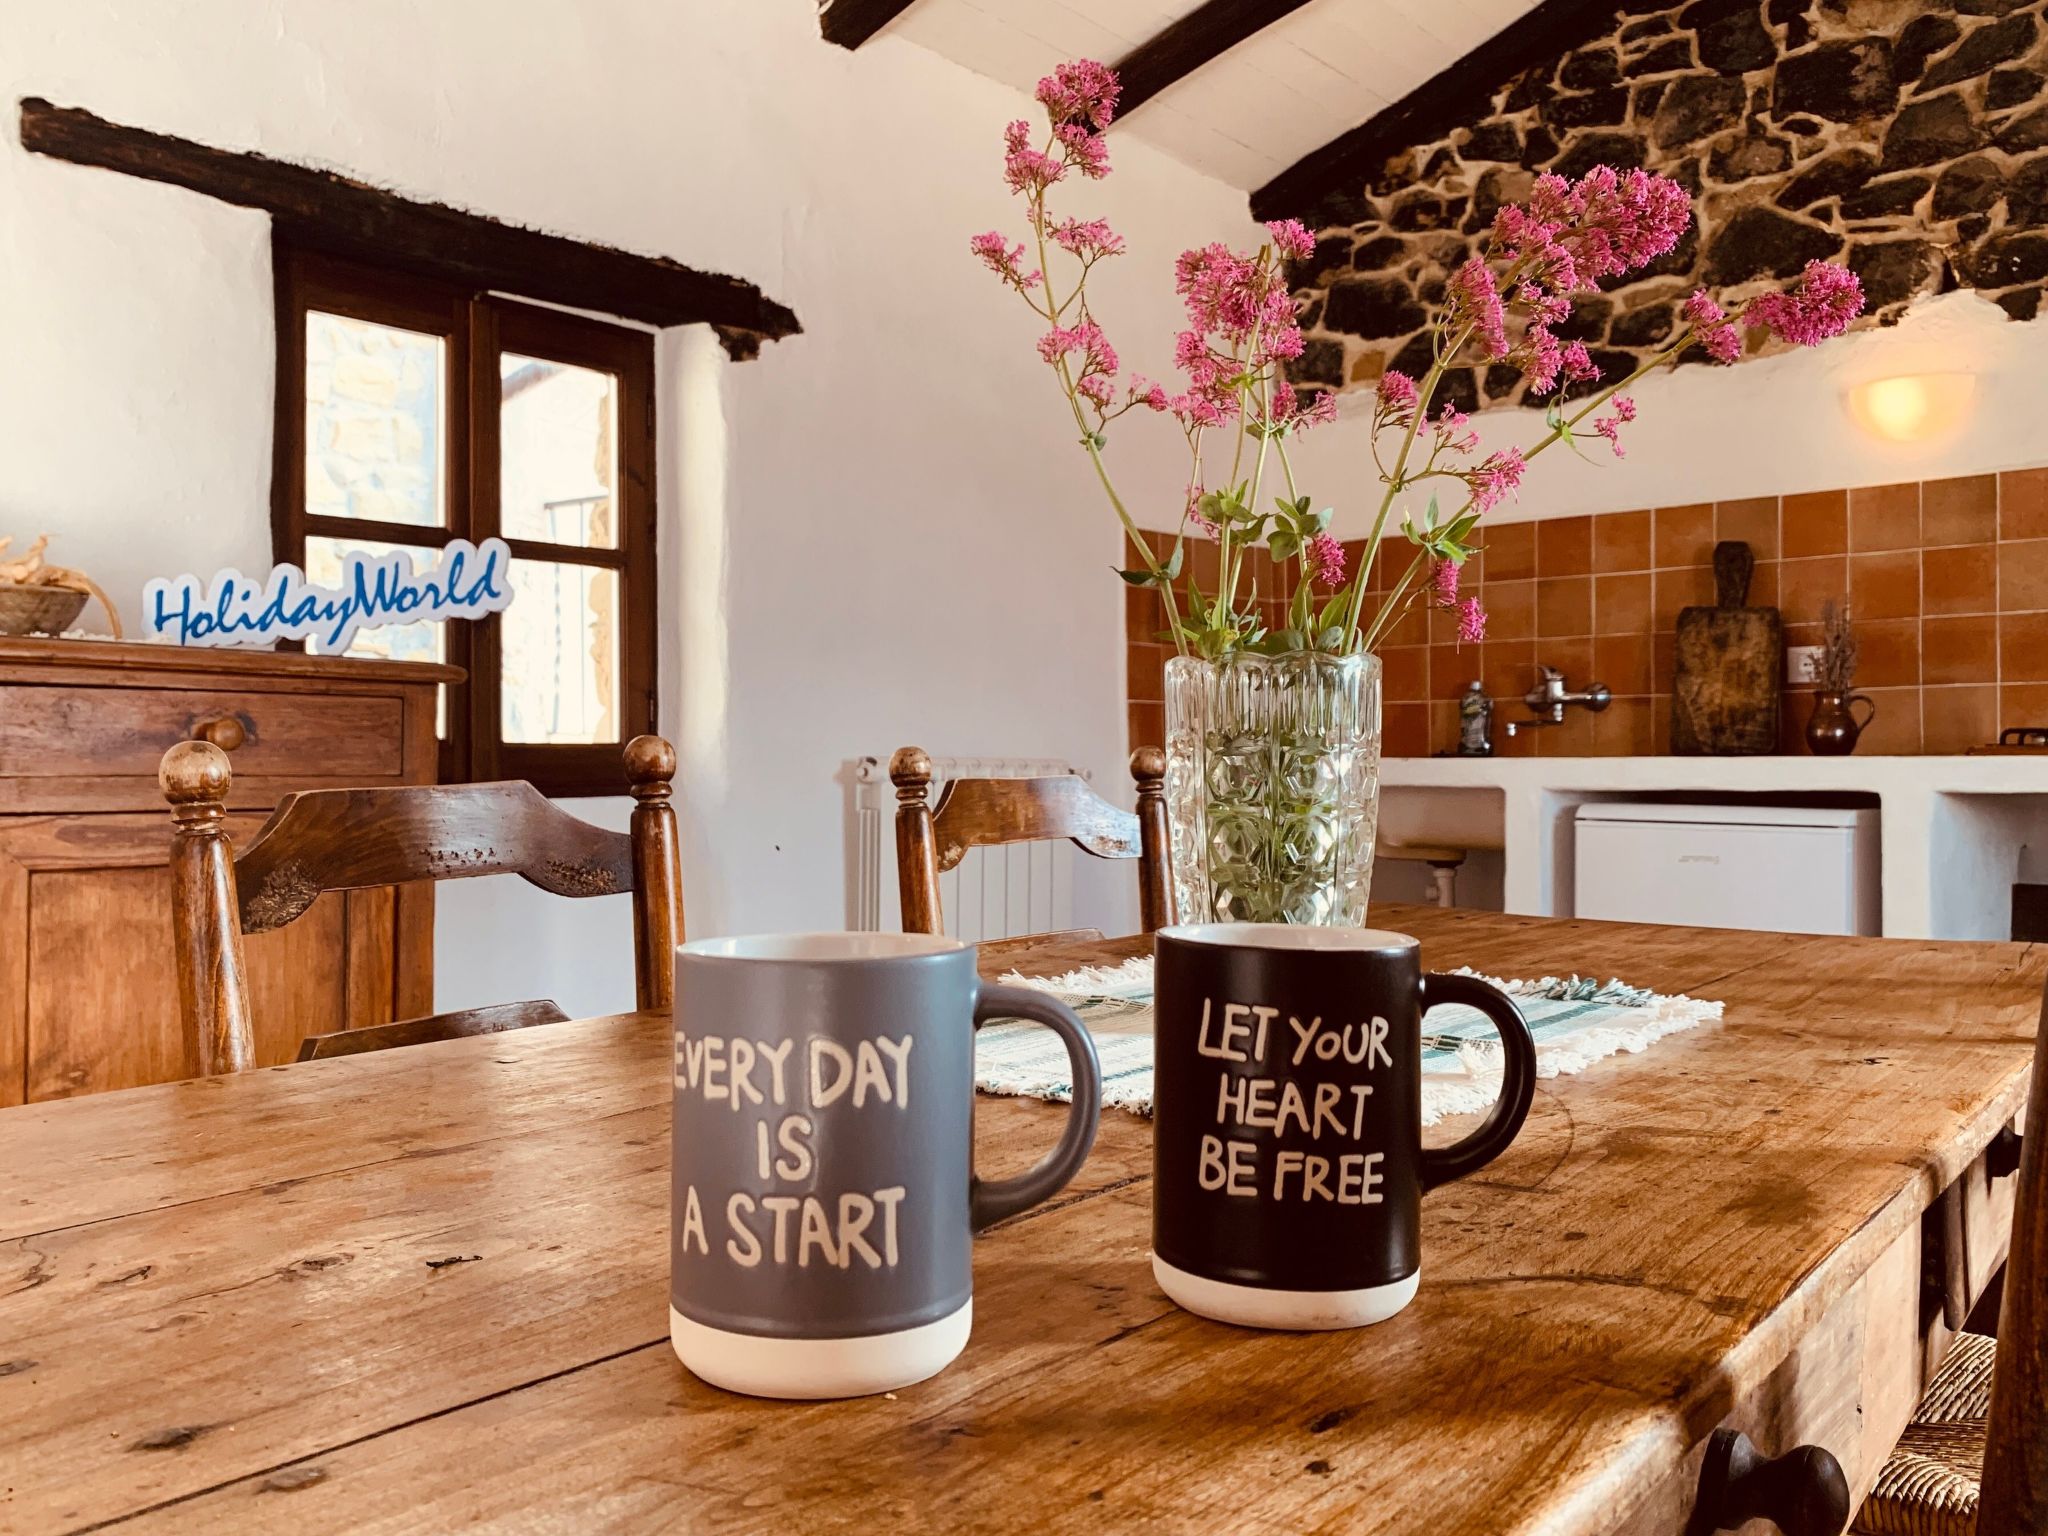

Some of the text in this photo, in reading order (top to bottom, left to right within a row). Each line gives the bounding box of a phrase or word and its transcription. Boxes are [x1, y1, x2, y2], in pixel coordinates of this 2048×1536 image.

[1198, 997, 1393, 1070] LET YOUR
[674, 1031, 913, 1112] EVERY DAY
[1217, 1073, 1374, 1140] HEART
[757, 1115, 812, 1181] IS
[1198, 1134, 1385, 1204] BE FREE
[683, 1185, 906, 1269] A START
